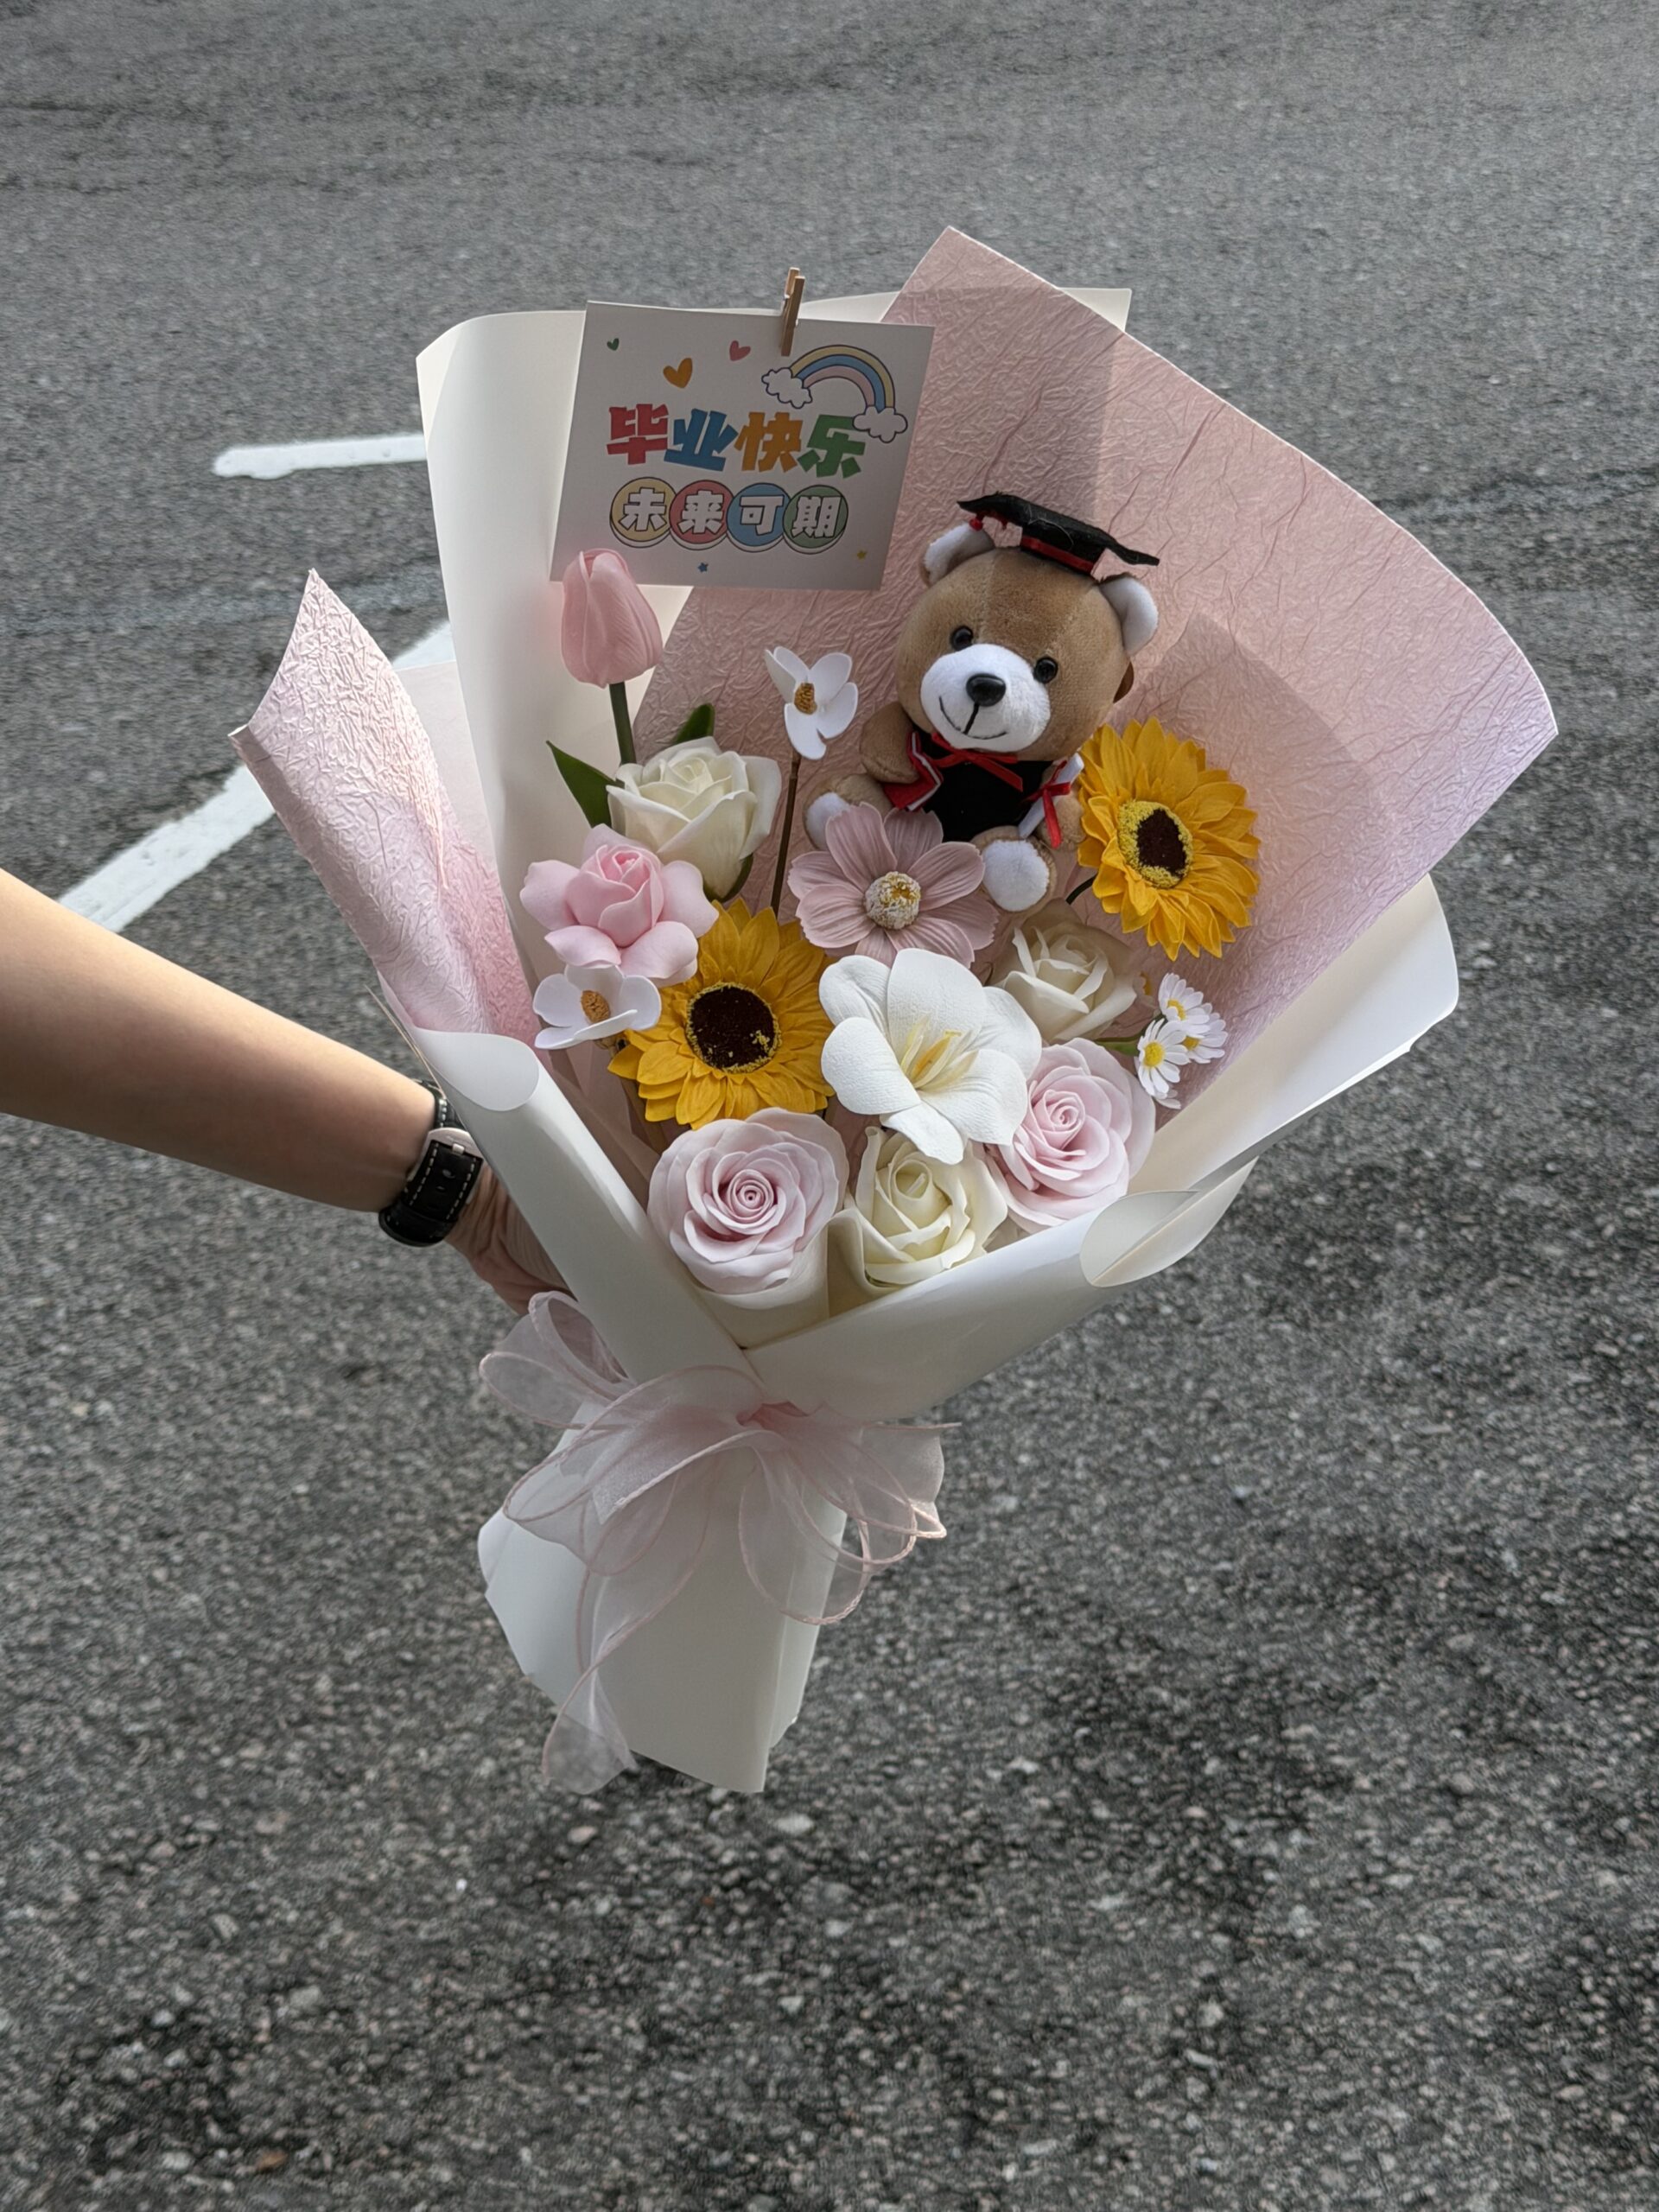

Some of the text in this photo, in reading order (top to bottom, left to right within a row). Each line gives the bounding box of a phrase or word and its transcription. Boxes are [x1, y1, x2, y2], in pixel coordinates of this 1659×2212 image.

[607, 404, 865, 478] 毕业快乐
[619, 487, 842, 537] 未来可期
